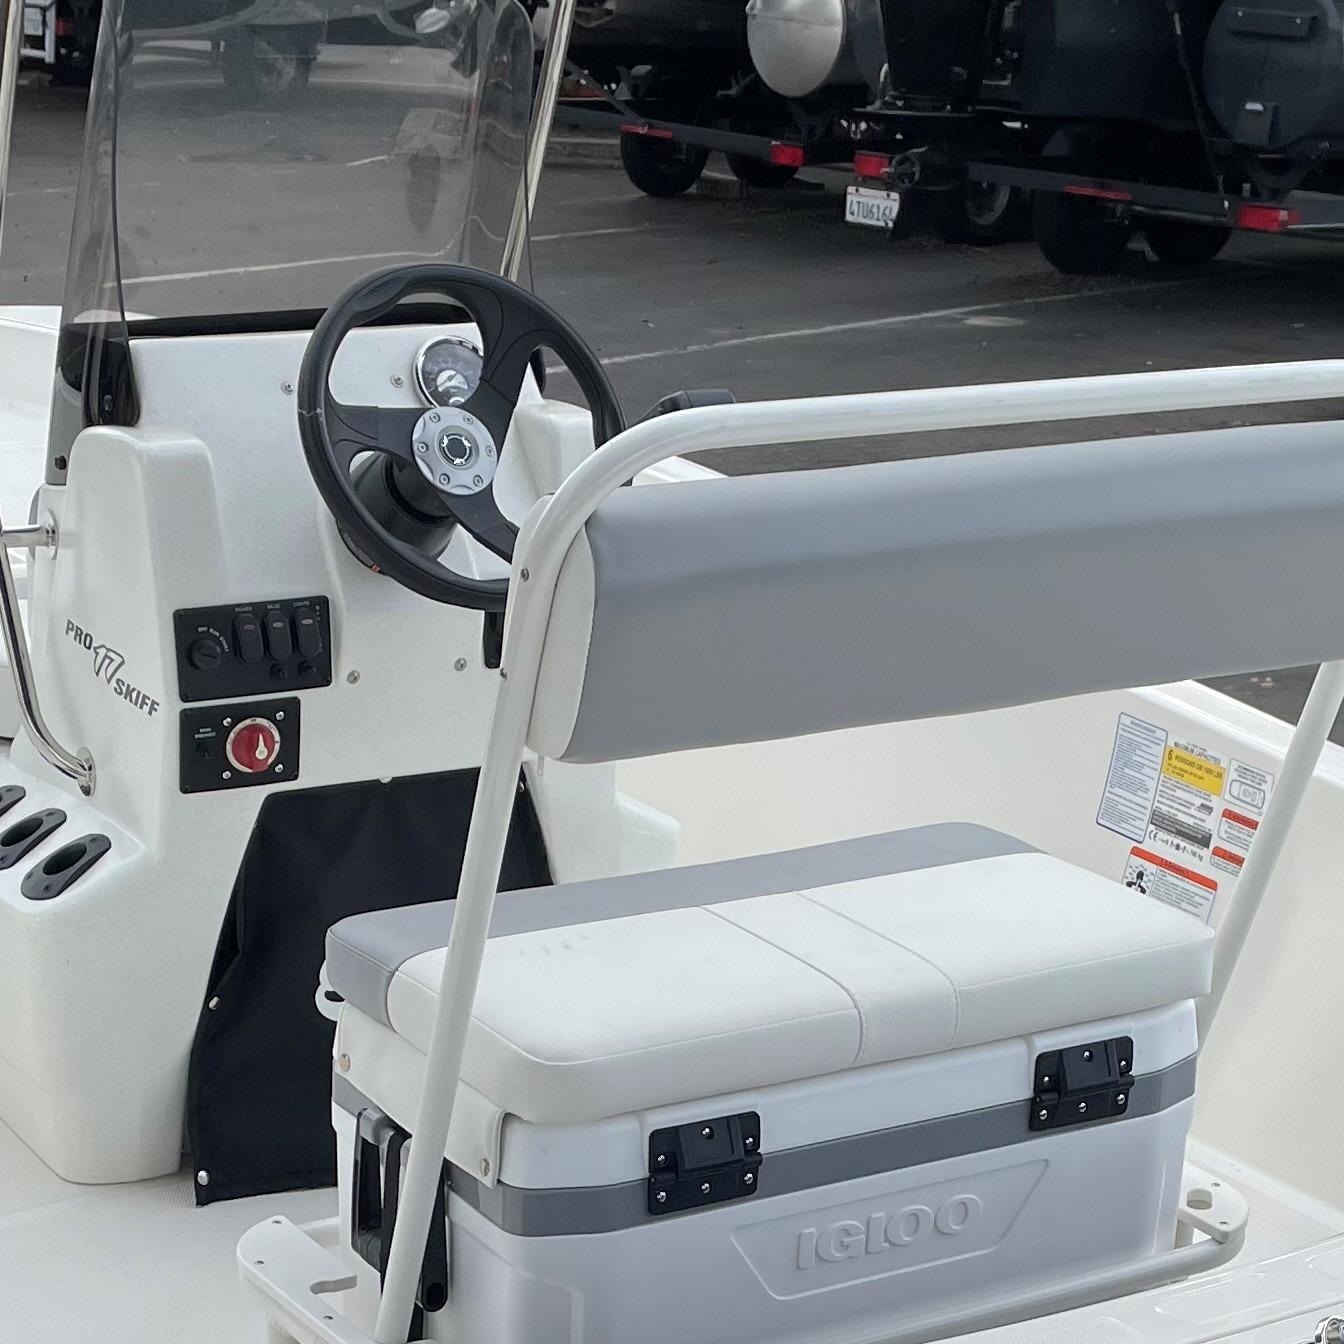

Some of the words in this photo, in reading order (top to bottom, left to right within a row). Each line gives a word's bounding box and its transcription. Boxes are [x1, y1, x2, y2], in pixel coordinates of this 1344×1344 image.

[65, 619, 93, 650] PRO
[93, 644, 125, 685] 17
[113, 678, 160, 716] SKIFF
[796, 1193, 983, 1270] IGLOO
